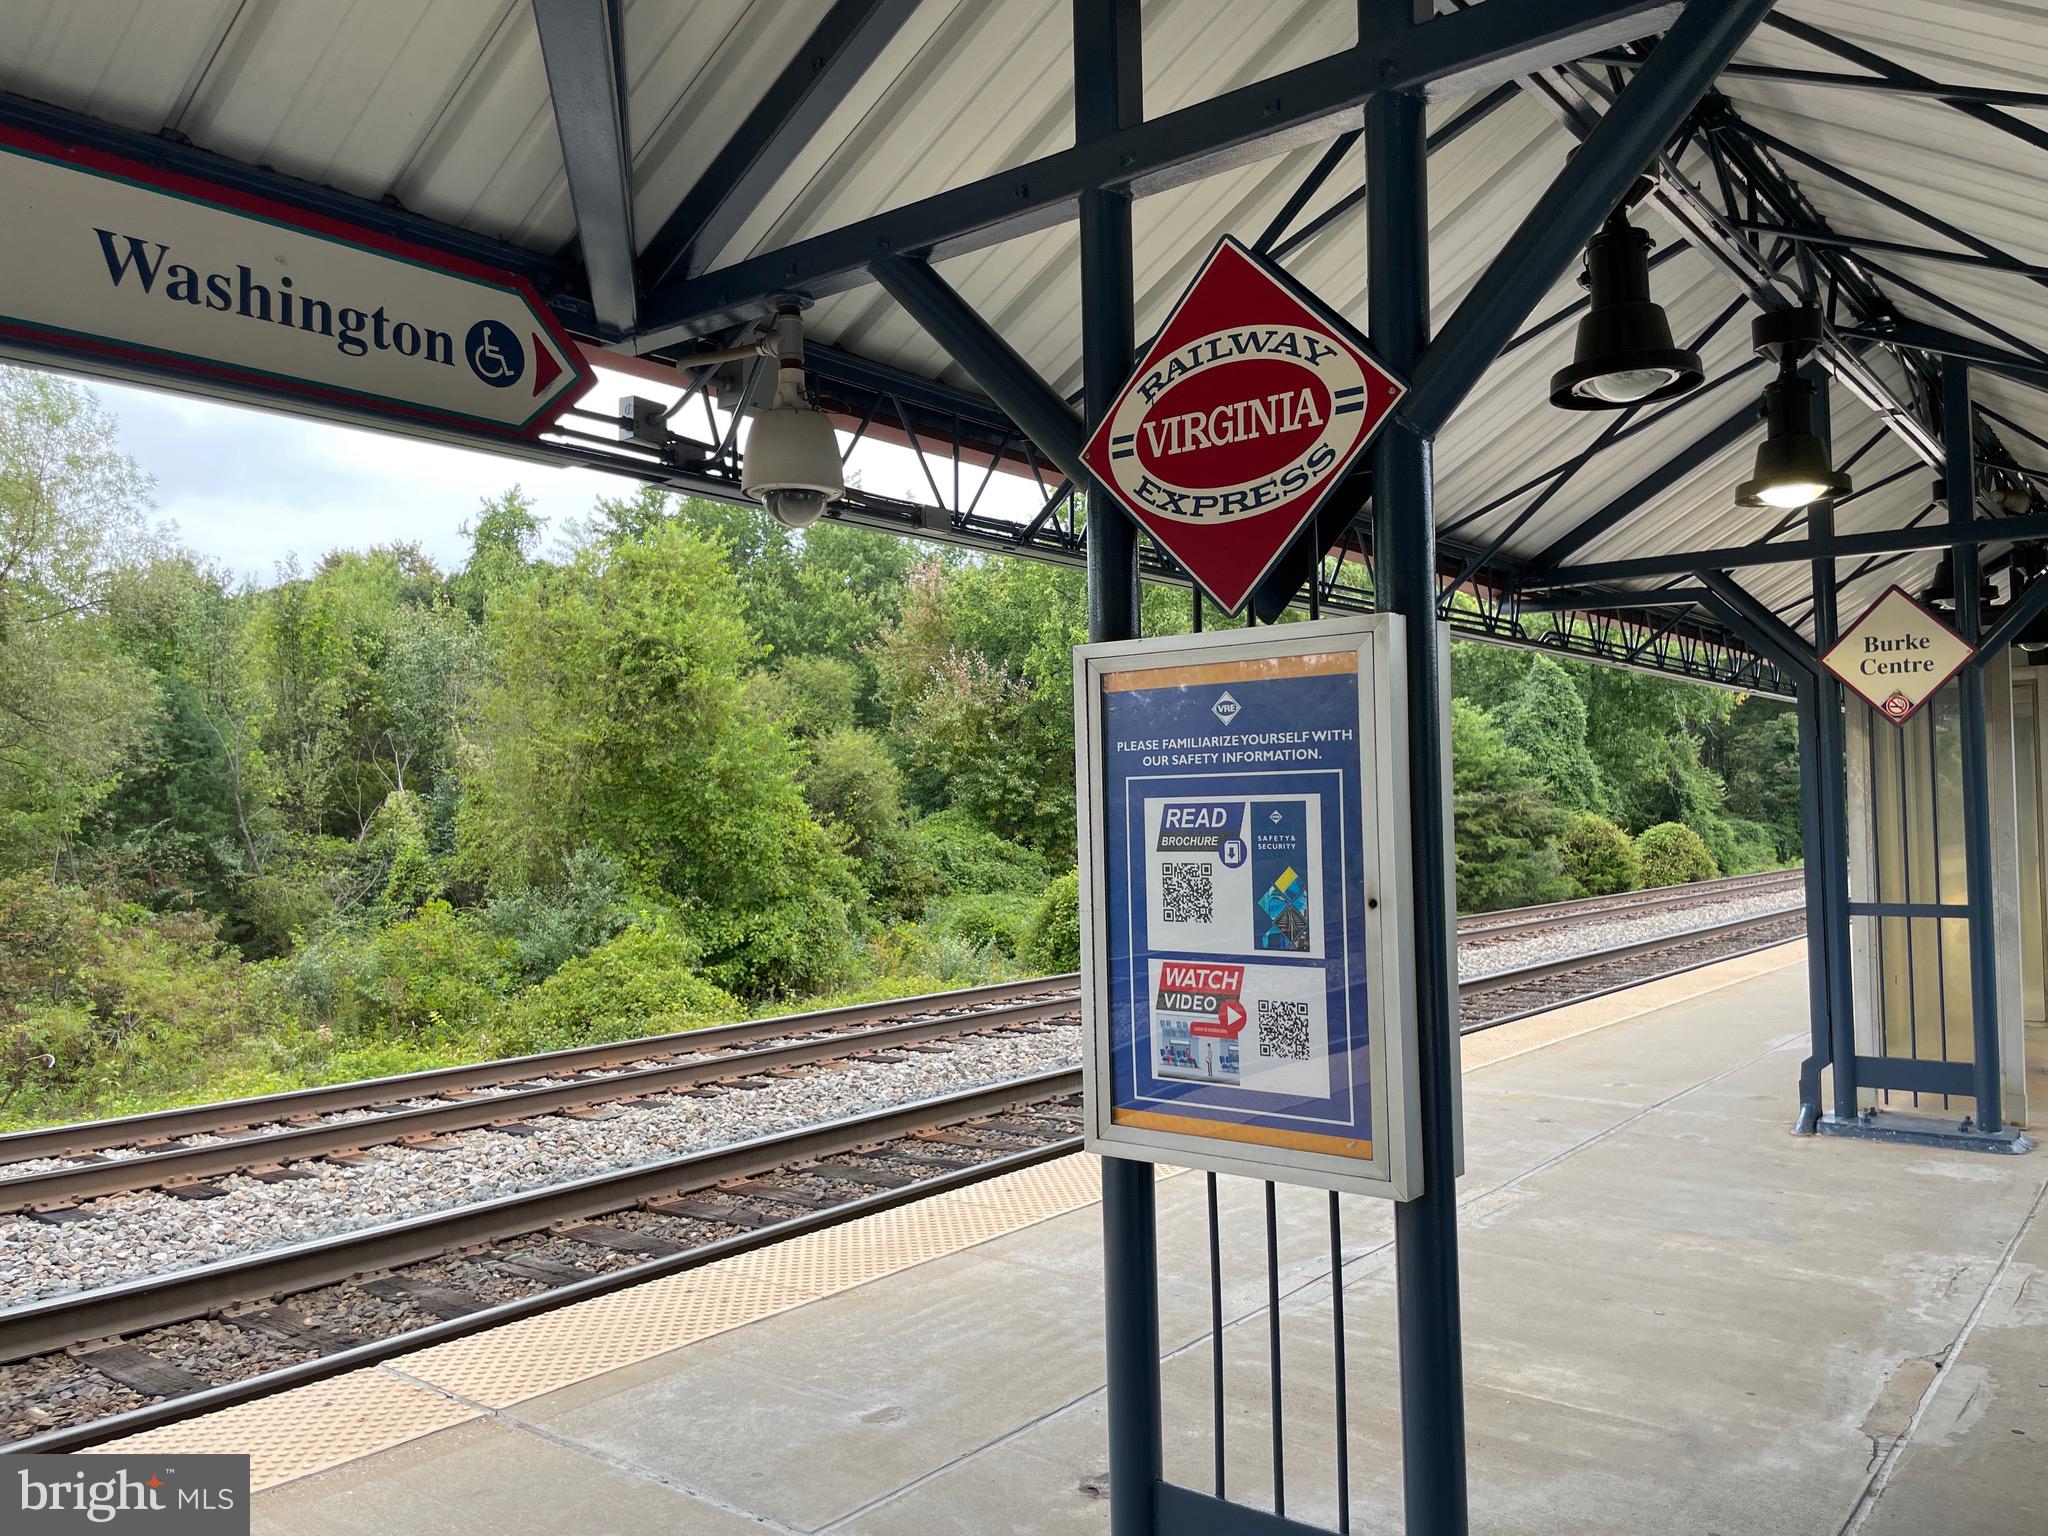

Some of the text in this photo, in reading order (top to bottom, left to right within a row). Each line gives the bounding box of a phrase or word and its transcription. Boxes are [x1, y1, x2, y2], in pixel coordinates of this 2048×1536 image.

[93, 227, 456, 367] Washington
[1136, 330, 1338, 407] RAILWAY
[1143, 387, 1324, 458] VIRGINIA
[1133, 442, 1337, 518] EXPRESS
[1863, 633, 1931, 653] Burke
[1859, 657, 1935, 676] Centre
[1217, 704, 1236, 713] VRE
[1117, 729, 1353, 752] PLEASE FAMILIARIZE YOURSELF WITH
[1142, 748, 1323, 767] OUR SAFETY INFORMATION.
[1165, 807, 1228, 829] READ
[1161, 836, 1219, 847] BROCHURE
[1166, 967, 1239, 990] WATCH
[1164, 992, 1217, 1011] VIDEO
